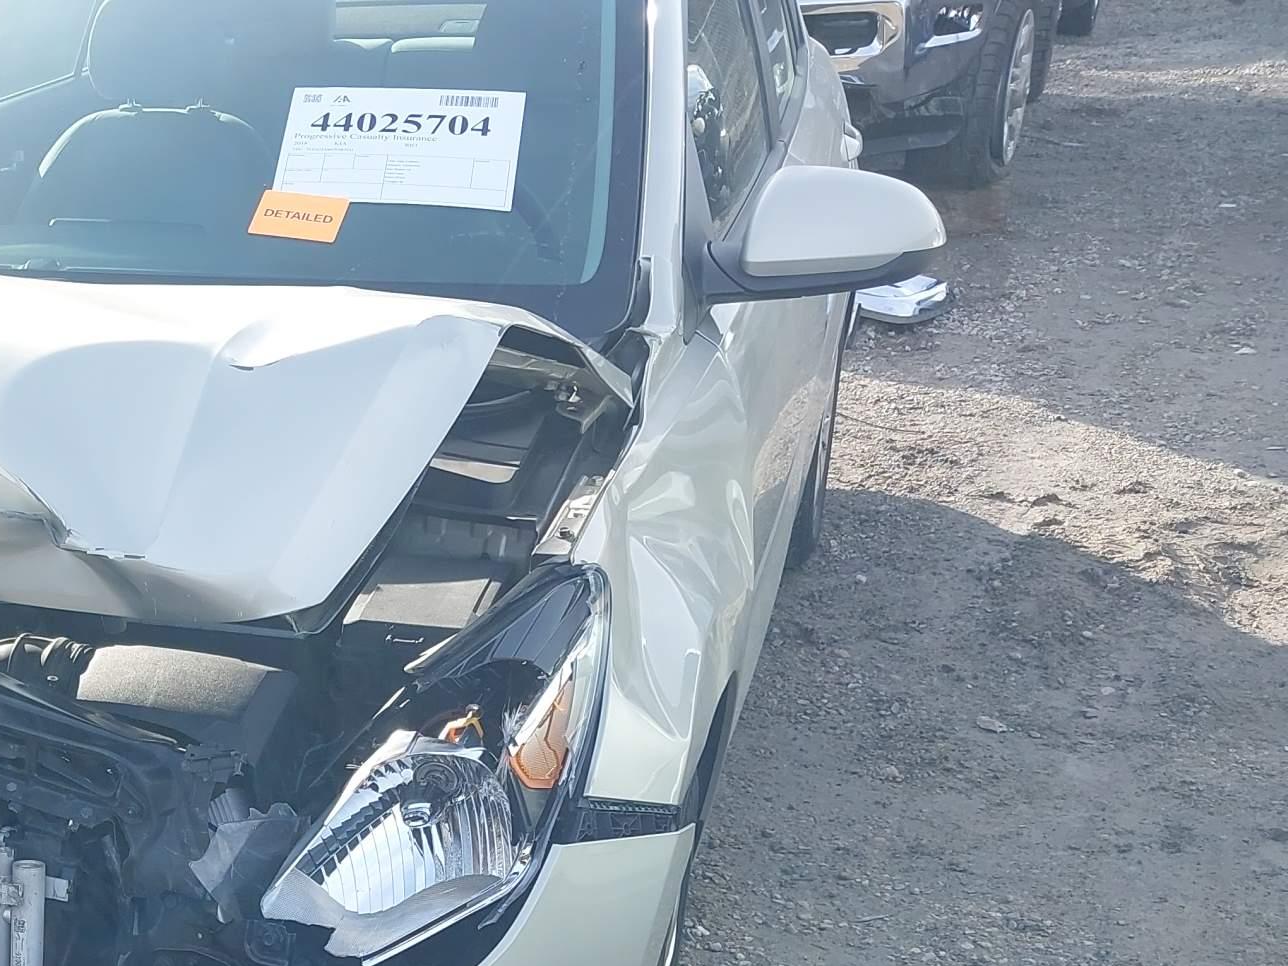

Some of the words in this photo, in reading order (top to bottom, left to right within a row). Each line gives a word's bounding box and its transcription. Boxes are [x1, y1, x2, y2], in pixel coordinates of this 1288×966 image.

[310, 112, 491, 136] 44025704
[294, 132, 347, 140] Progressive
[393, 134, 438, 142] Insurance
[263, 208, 334, 224] DETAILED
